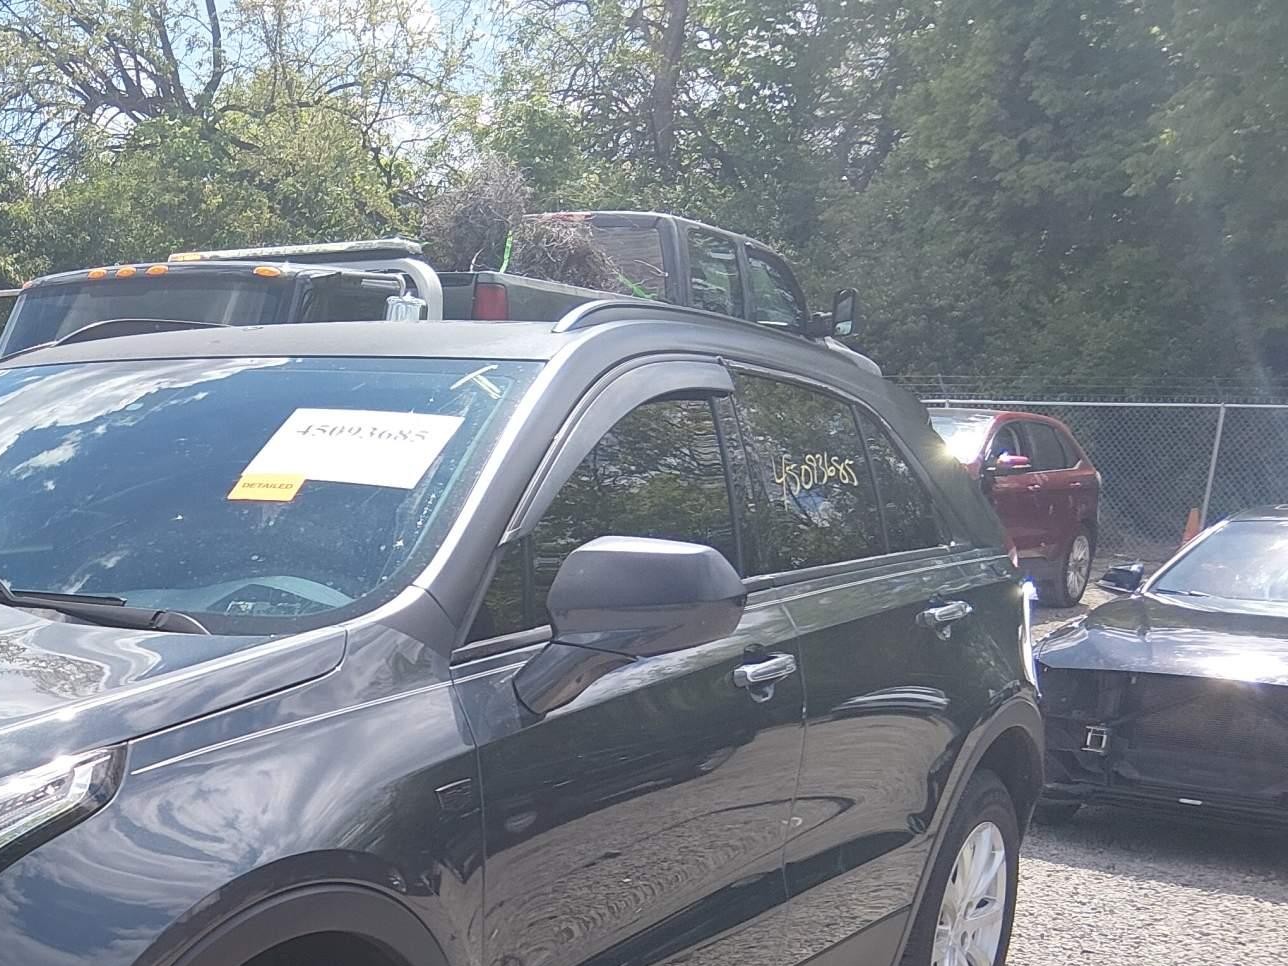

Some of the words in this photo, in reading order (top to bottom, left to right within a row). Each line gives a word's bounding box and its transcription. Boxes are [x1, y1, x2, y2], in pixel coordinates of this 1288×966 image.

[296, 424, 430, 443] 45093685
[241, 481, 294, 491] DETAILED
[770, 451, 859, 513] 45093685
